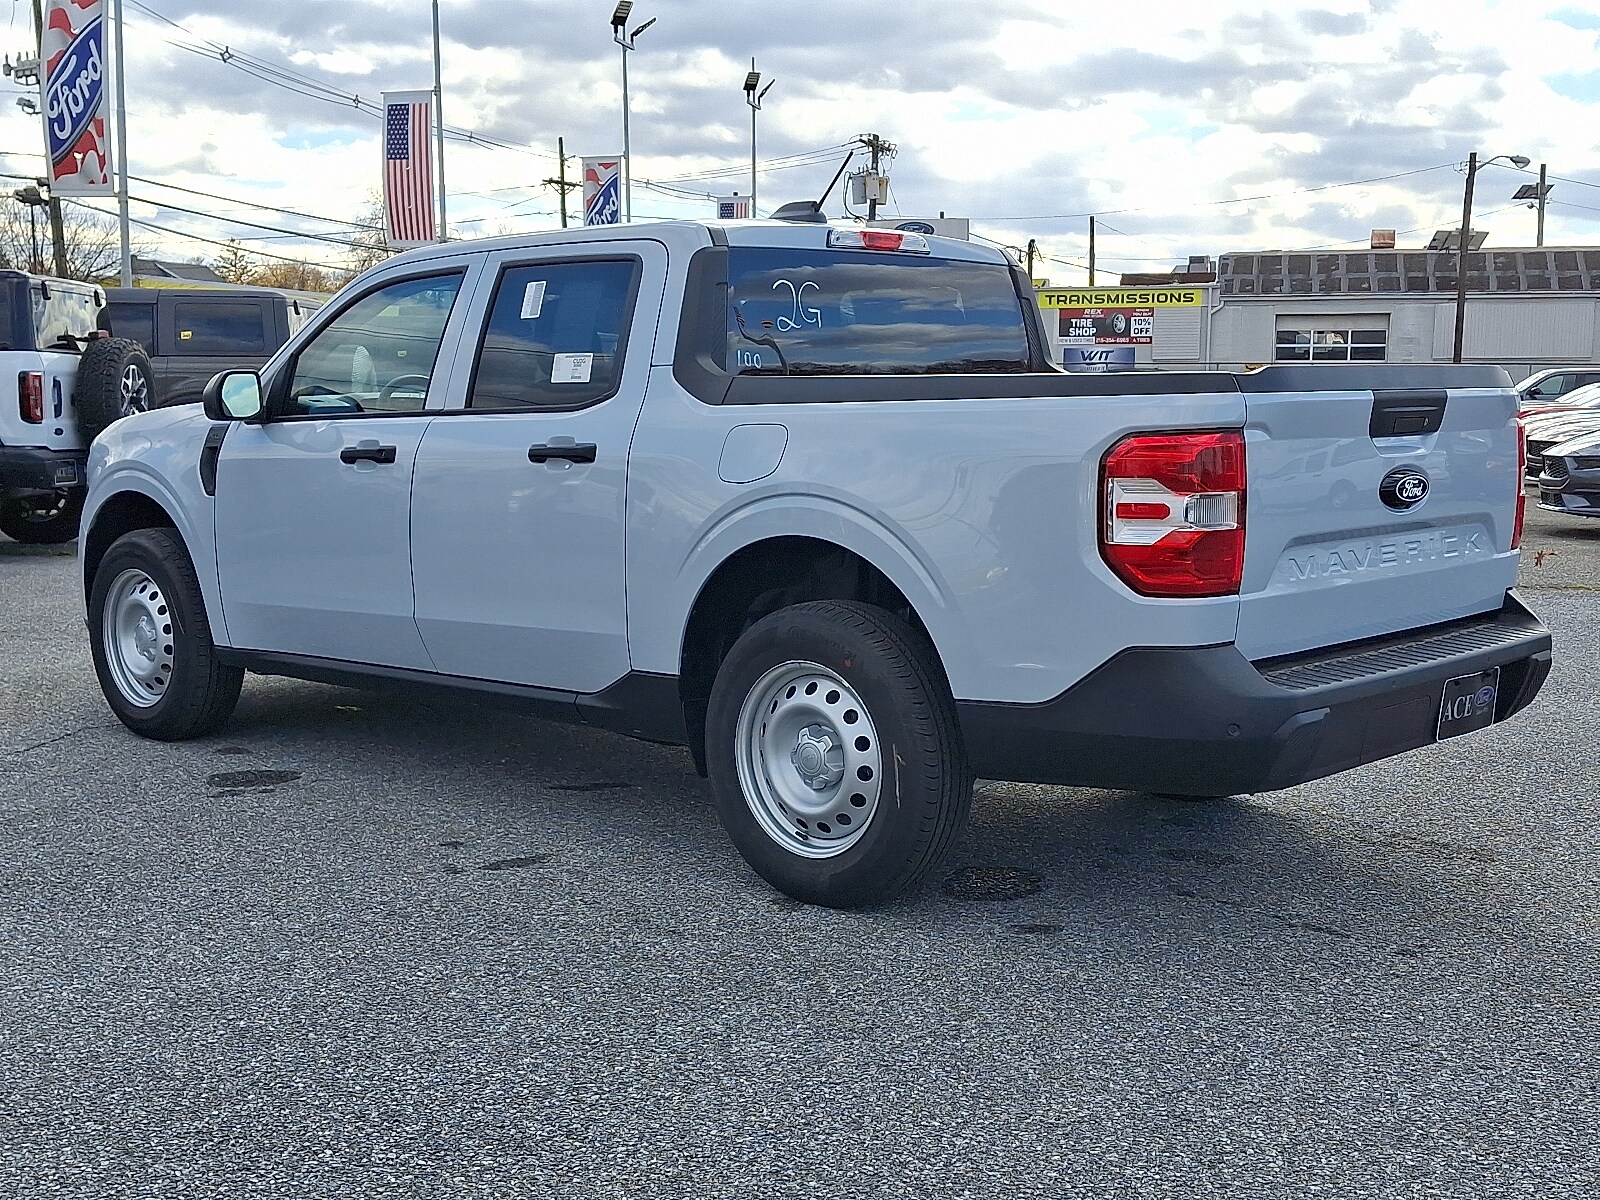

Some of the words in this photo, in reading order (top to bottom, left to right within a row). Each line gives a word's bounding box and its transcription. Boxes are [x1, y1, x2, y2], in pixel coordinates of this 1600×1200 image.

[48, 39, 102, 140] Ford
[772, 279, 821, 331] 2G
[1045, 292, 1195, 305] TRANSMISSIONS
[1070, 318, 1093, 328] TIRE
[1133, 318, 1152, 327] 10%
[1068, 327, 1097, 337] SHOP
[1133, 327, 1151, 335] OFF
[737, 349, 762, 369] 100
[1080, 349, 1115, 362] WIT
[1403, 479, 1423, 497] Ford
[1288, 532, 1481, 582] MAVERICK
[1442, 693, 1475, 722] ACE
